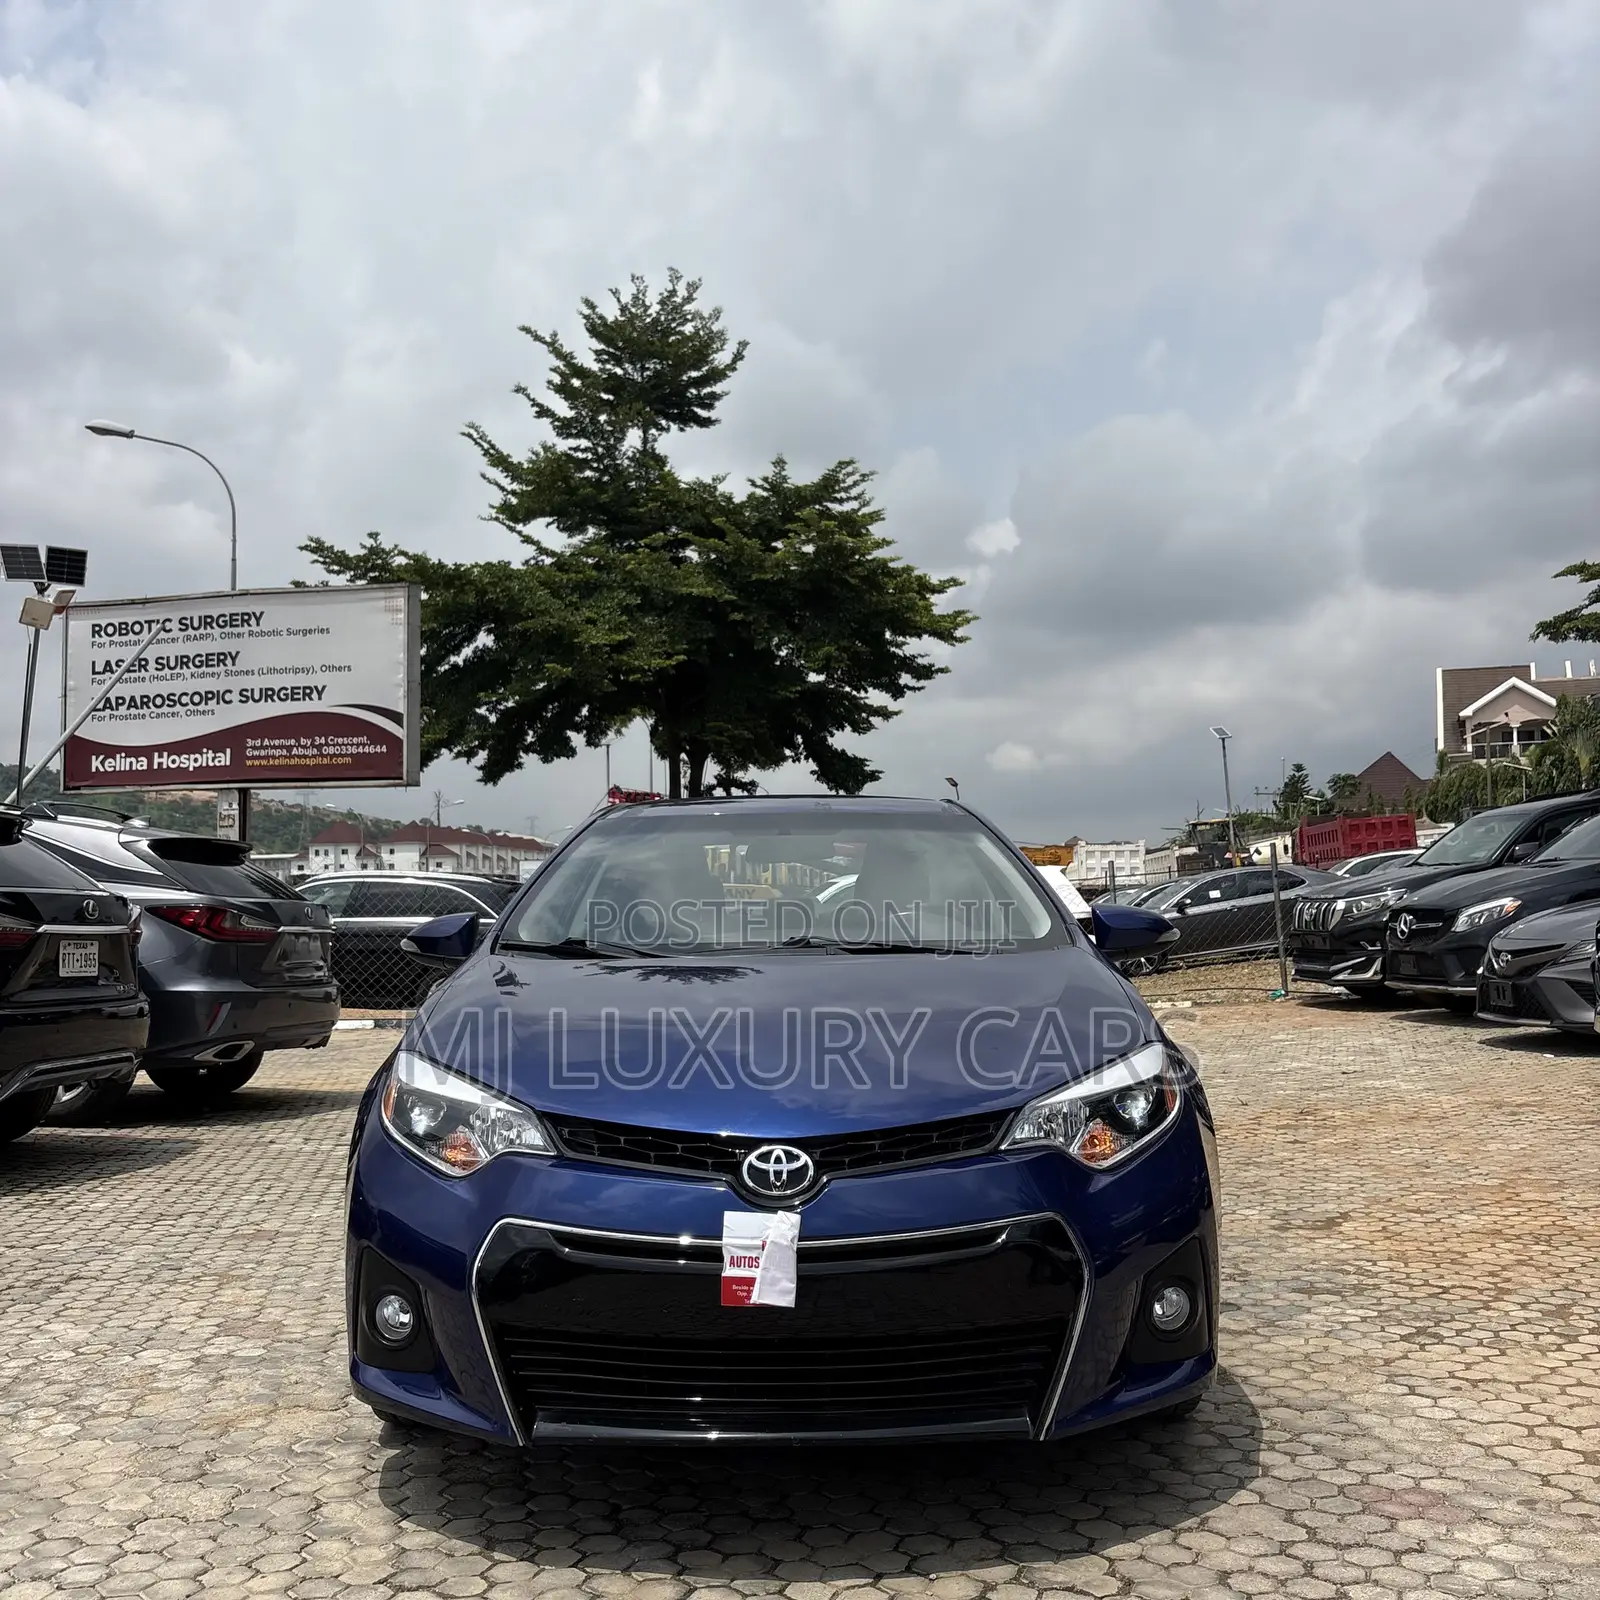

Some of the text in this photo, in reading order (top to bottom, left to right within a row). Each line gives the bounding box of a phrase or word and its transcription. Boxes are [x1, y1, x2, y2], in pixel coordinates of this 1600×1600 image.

[178, 611, 265, 632] SURGERY
[91, 641, 106, 649] For
[182, 633, 217, 644] (RARP),
[220, 631, 245, 640] Other
[248, 628, 283, 638] Robotic
[286, 626, 330, 637] Surgeries
[91, 651, 241, 675] LASER SURGERY
[91, 663, 352, 686] For ostate (HoLEP), Kidney Stones (Lithotripsy), Others
[238, 685, 327, 704] SURGERY
[91, 708, 215, 722] For Prostate Cancer, Others
[246, 735, 370, 747] 3rd Avenue, by 34 Crescent,
[91, 748, 231, 772] Kelina Hospital
[246, 747, 290, 757] Gwarinpa,
[322, 745, 387, 754] 08033644644
[246, 756, 352, 767] www.kelinahospital.com
[729, 1255, 760, 1268] AUTOS
